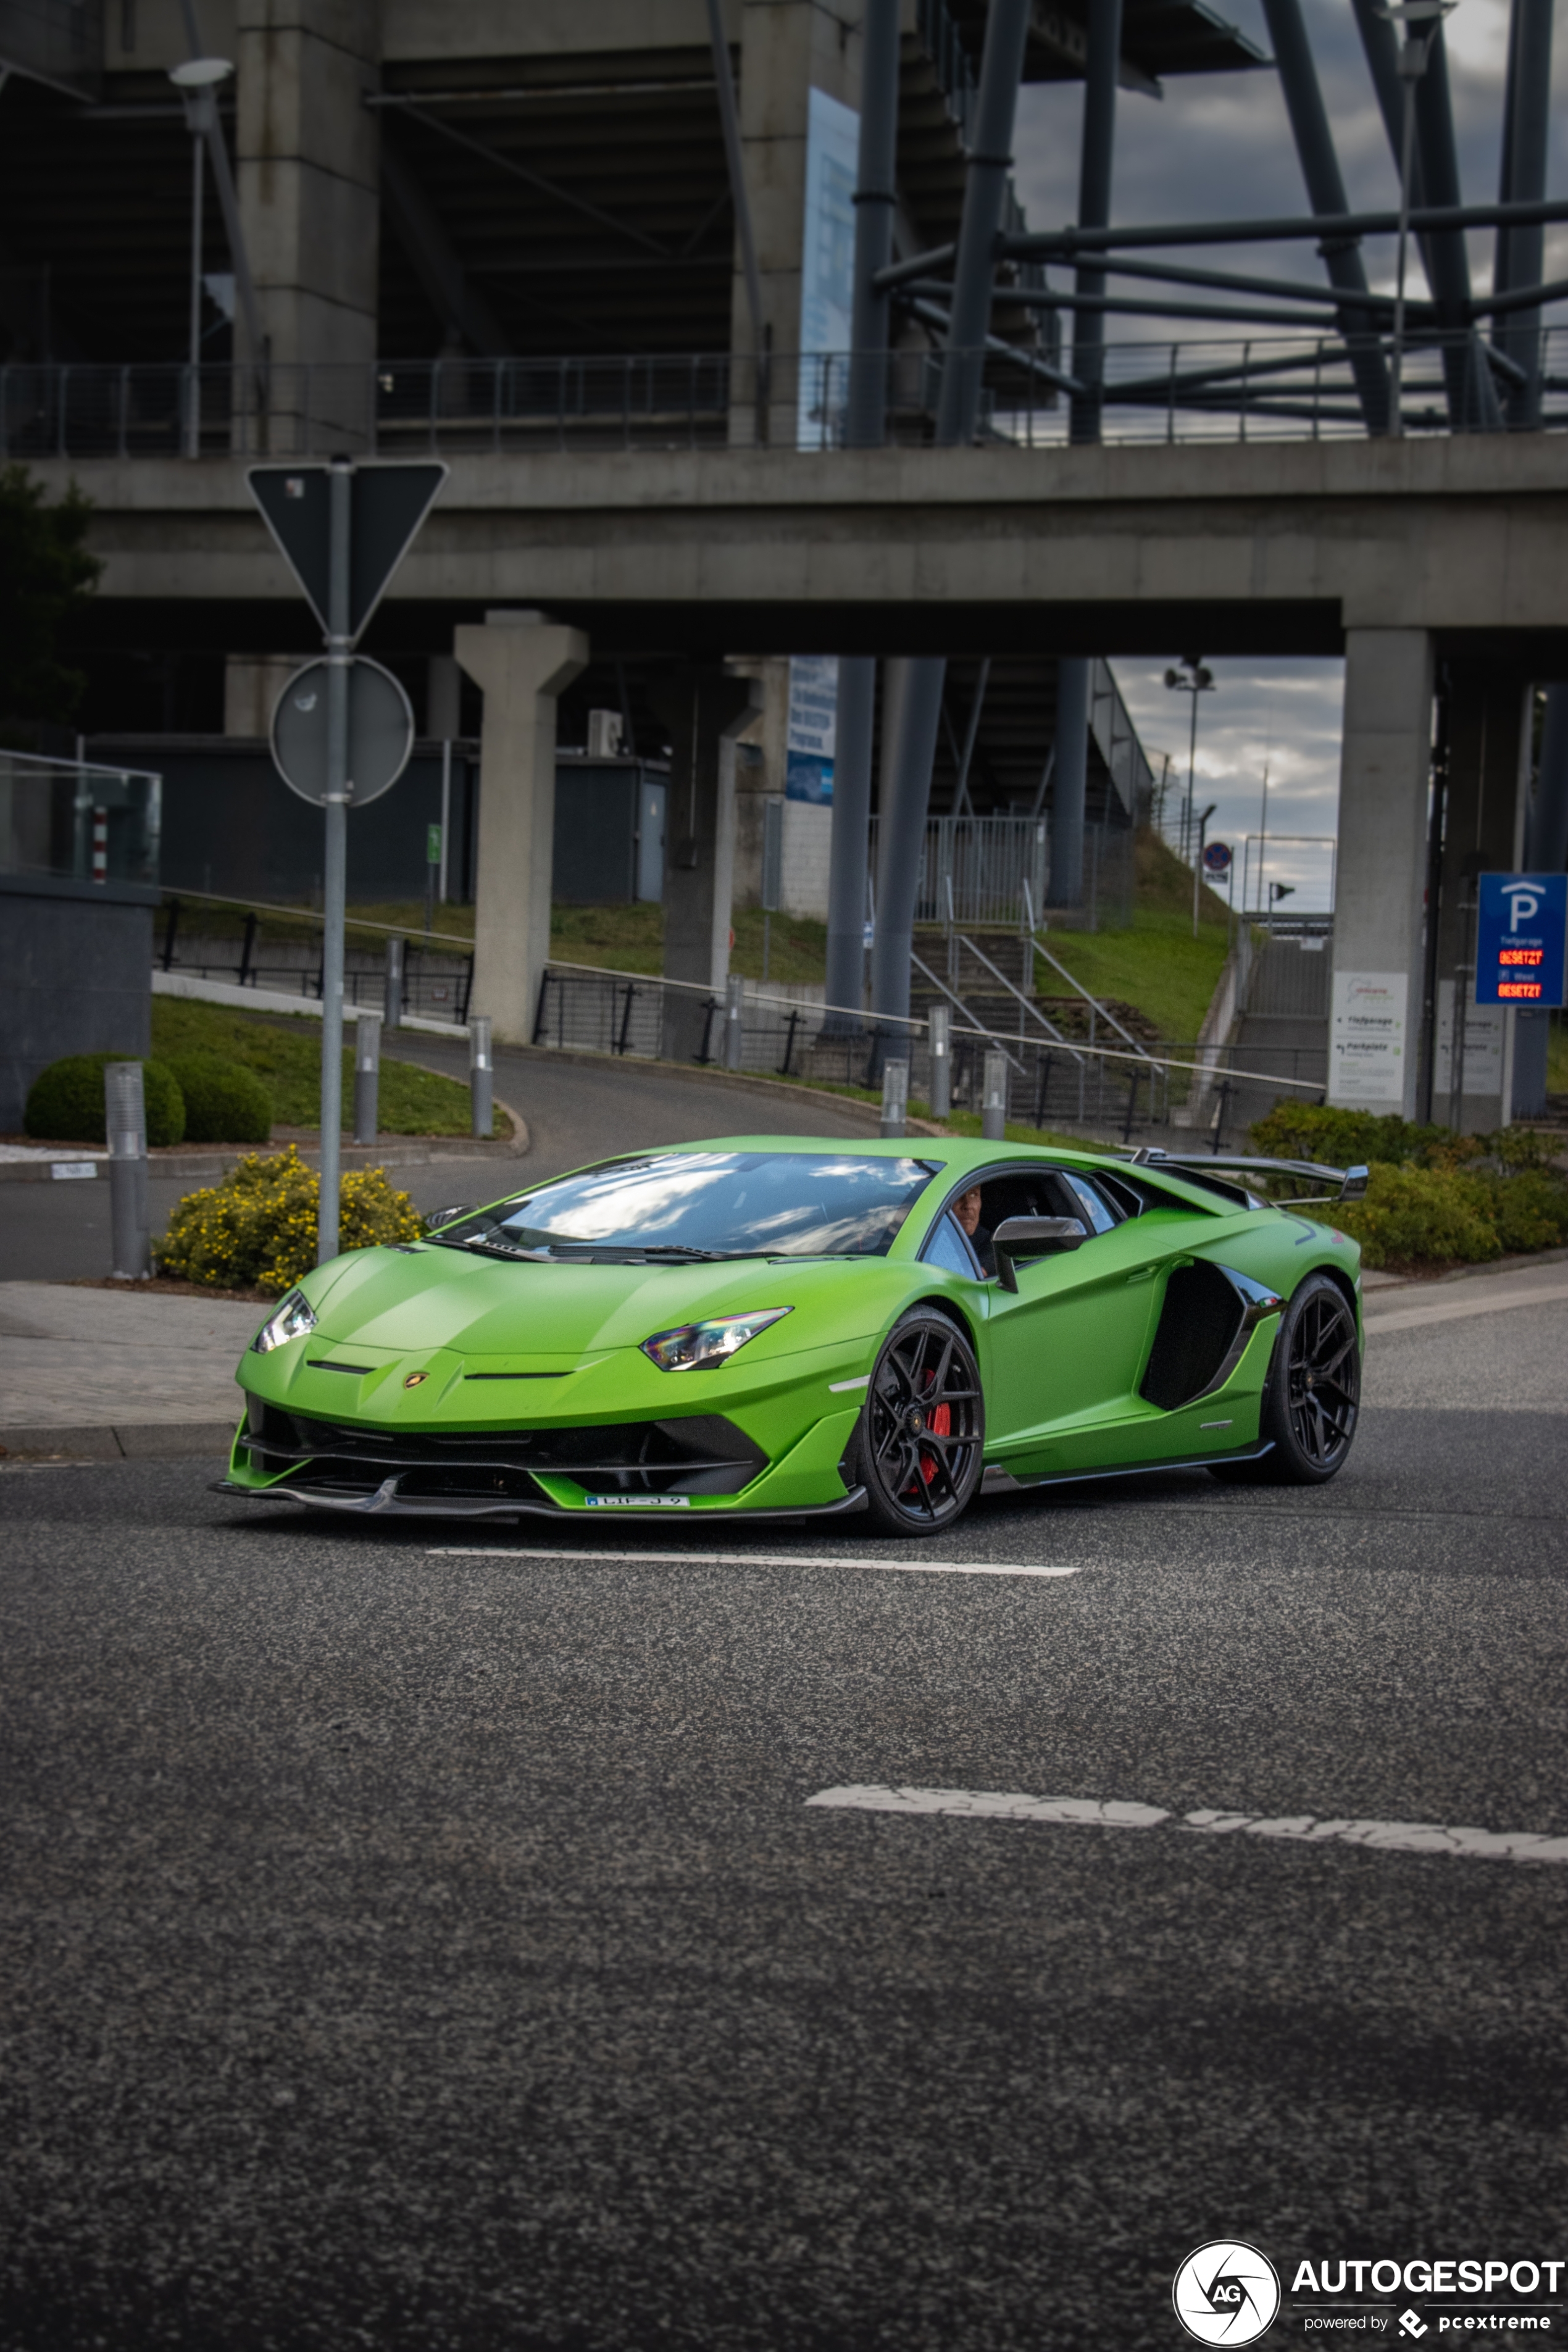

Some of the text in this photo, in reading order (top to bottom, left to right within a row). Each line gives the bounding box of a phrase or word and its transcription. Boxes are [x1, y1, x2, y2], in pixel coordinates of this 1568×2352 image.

[1510, 894, 1538, 933] P
[1499, 950, 1544, 965] BESETZT
[1498, 983, 1542, 998] BESETZT
